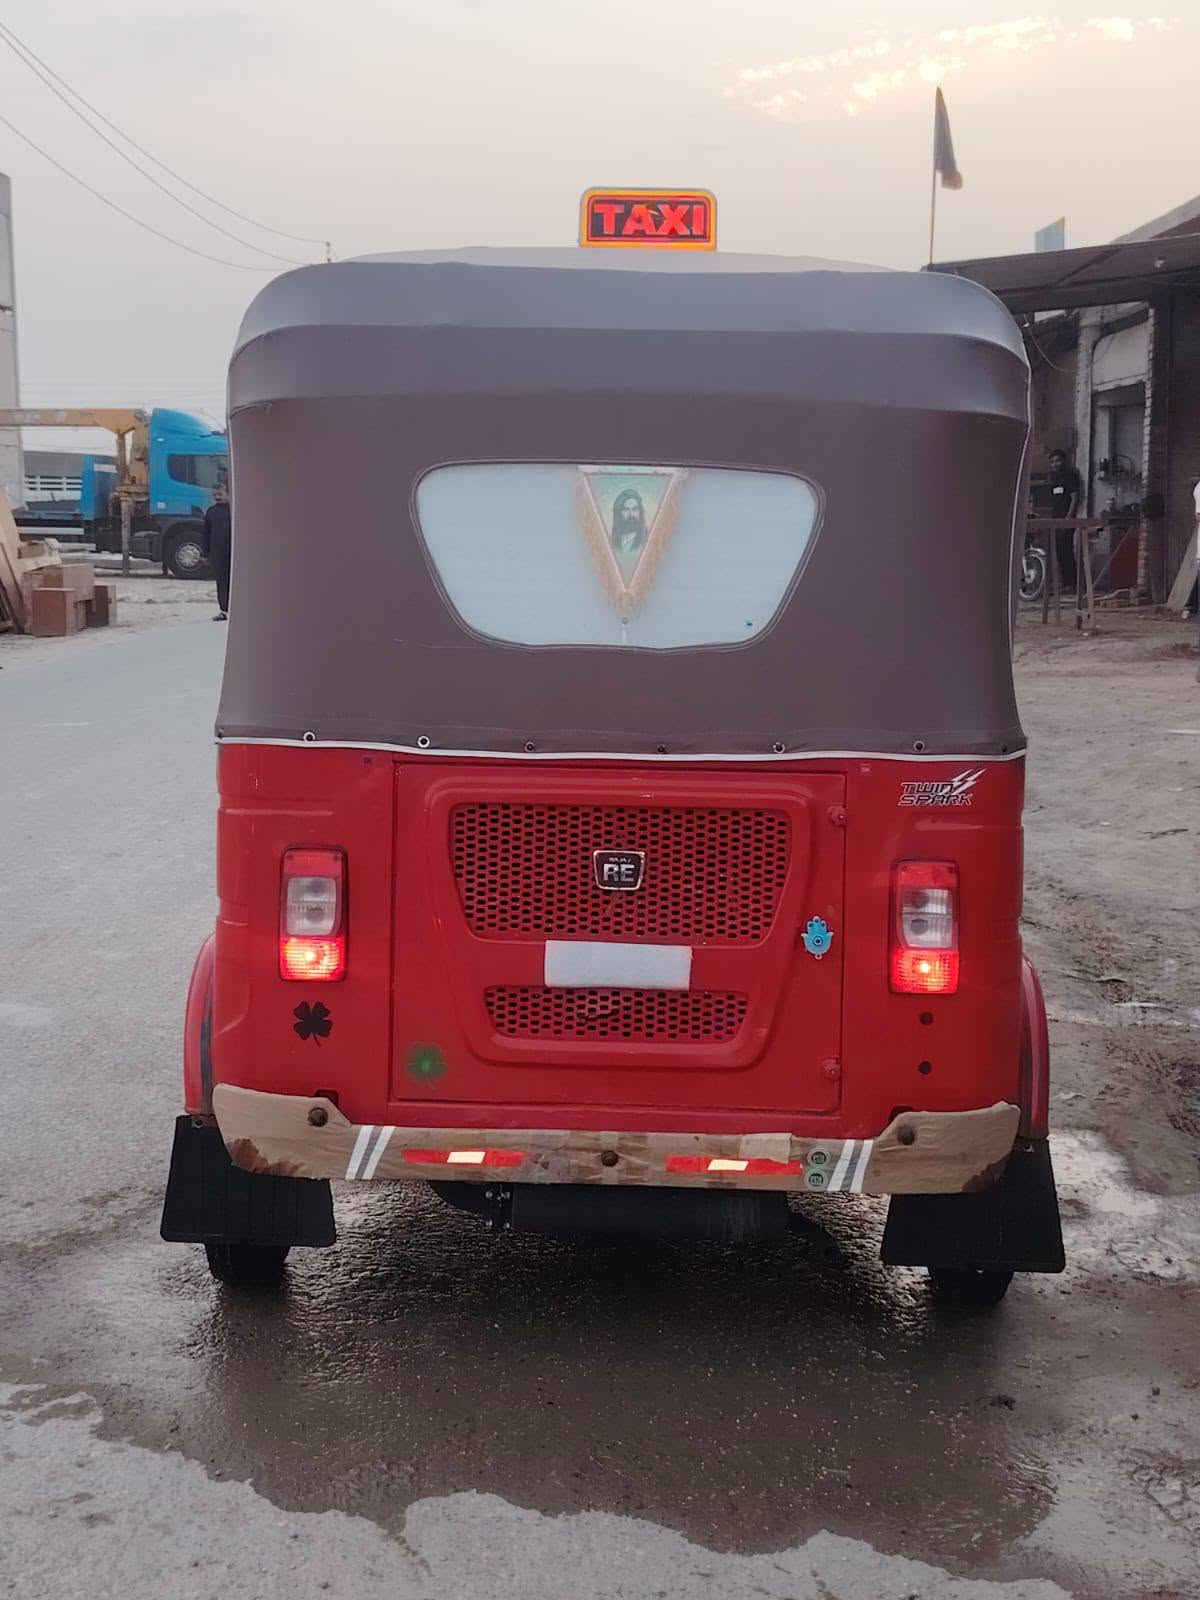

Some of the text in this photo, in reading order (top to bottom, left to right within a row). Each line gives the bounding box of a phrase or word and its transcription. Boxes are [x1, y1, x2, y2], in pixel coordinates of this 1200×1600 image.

[594, 203, 705, 235] TAXI
[900, 781, 955, 794] TWIN
[898, 793, 974, 806] SPARK
[603, 863, 635, 881] RE
